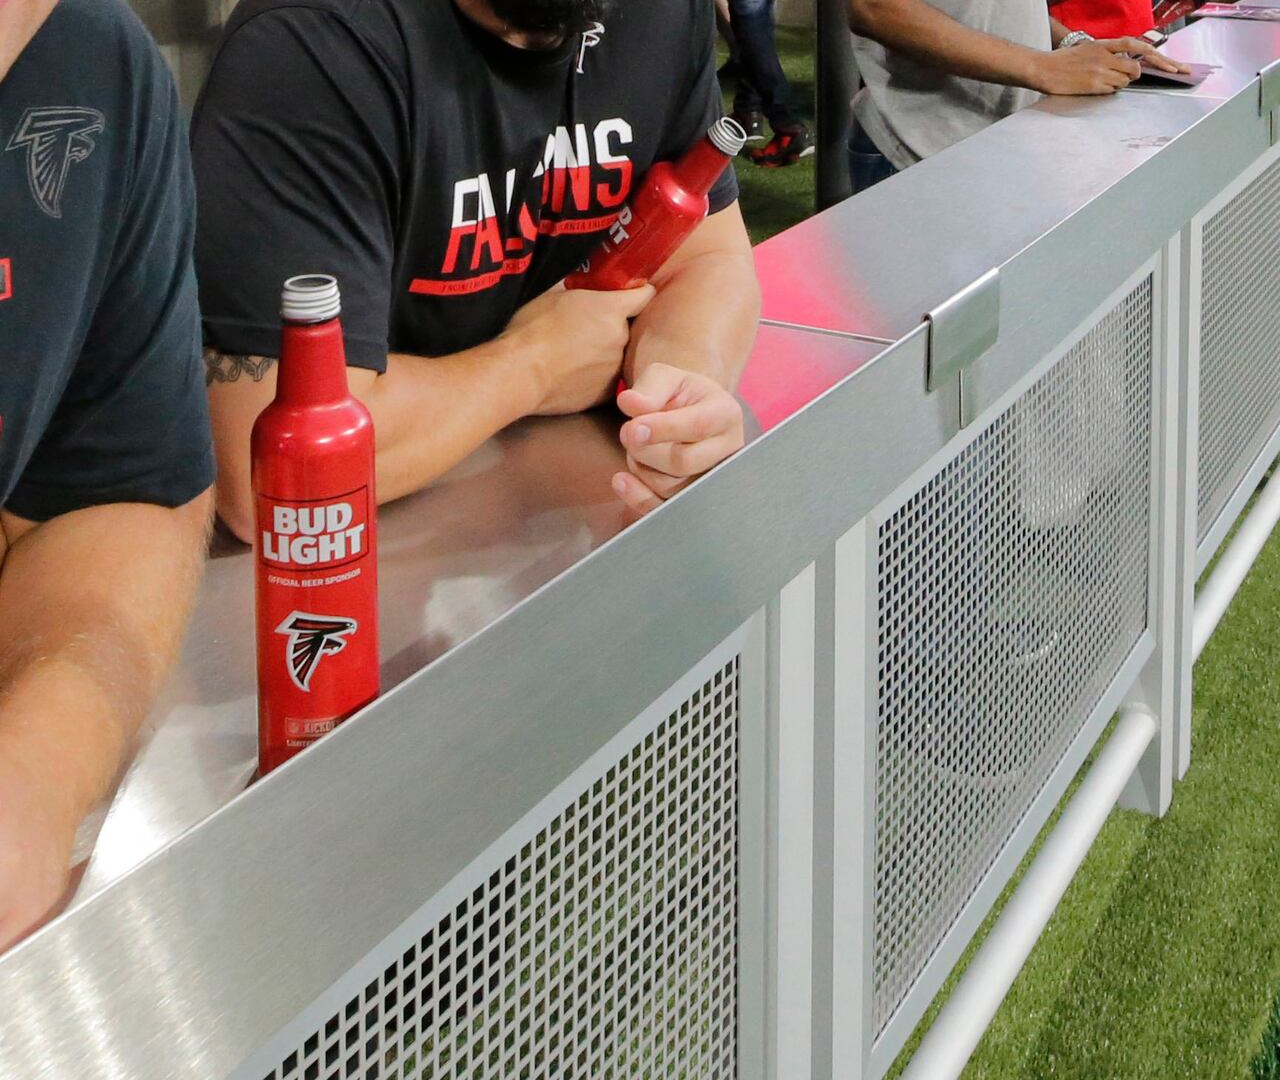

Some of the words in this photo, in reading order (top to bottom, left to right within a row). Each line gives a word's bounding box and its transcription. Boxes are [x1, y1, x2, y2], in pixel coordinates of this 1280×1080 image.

[441, 117, 633, 274] FANS
[273, 502, 353, 536] BUD
[262, 523, 365, 565] LIGHT
[267, 574, 300, 588] OFFICIAL
[301, 578, 324, 587] BEER
[324, 567, 361, 585] SPONSOR
